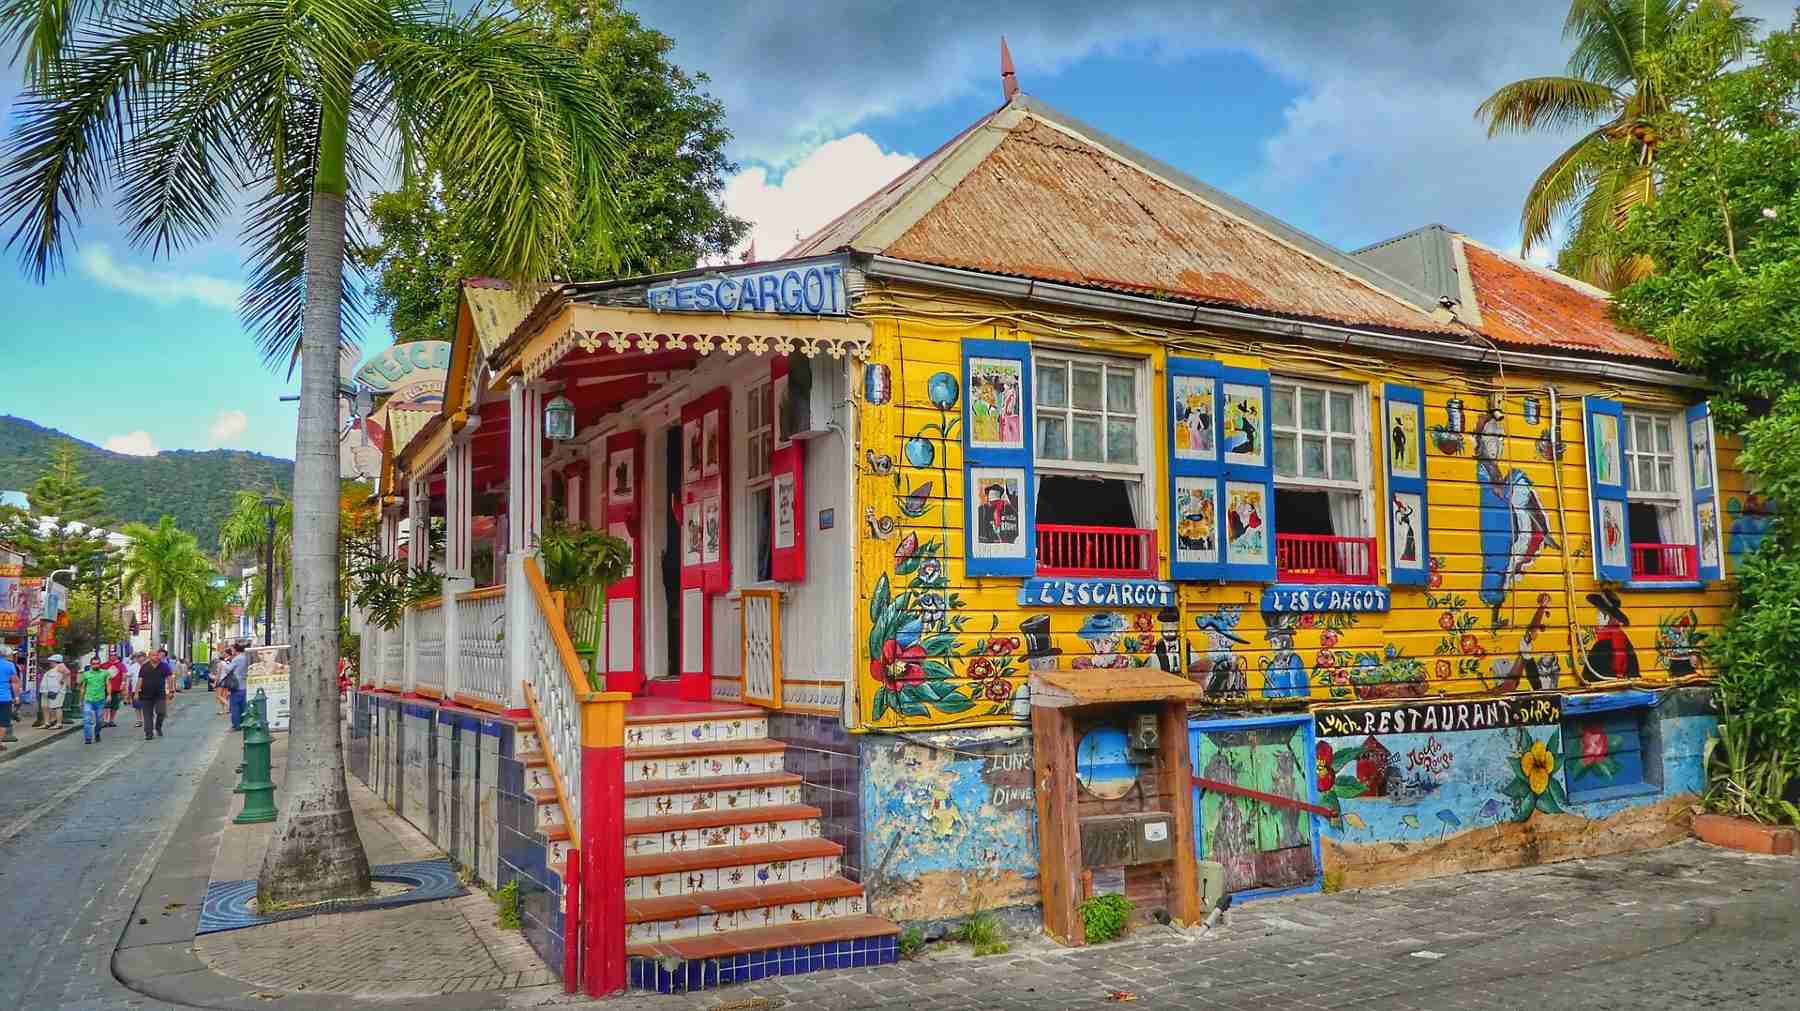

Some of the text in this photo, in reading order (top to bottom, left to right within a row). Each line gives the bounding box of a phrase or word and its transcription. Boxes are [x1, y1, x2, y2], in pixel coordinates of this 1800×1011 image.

[650, 266, 842, 313] L'ESCARGOT
[1039, 582, 1171, 607] L'ESCARGOT
[1272, 590, 1387, 612] L'ESCARGOT
[1363, 699, 1512, 735] RESTAURANT
